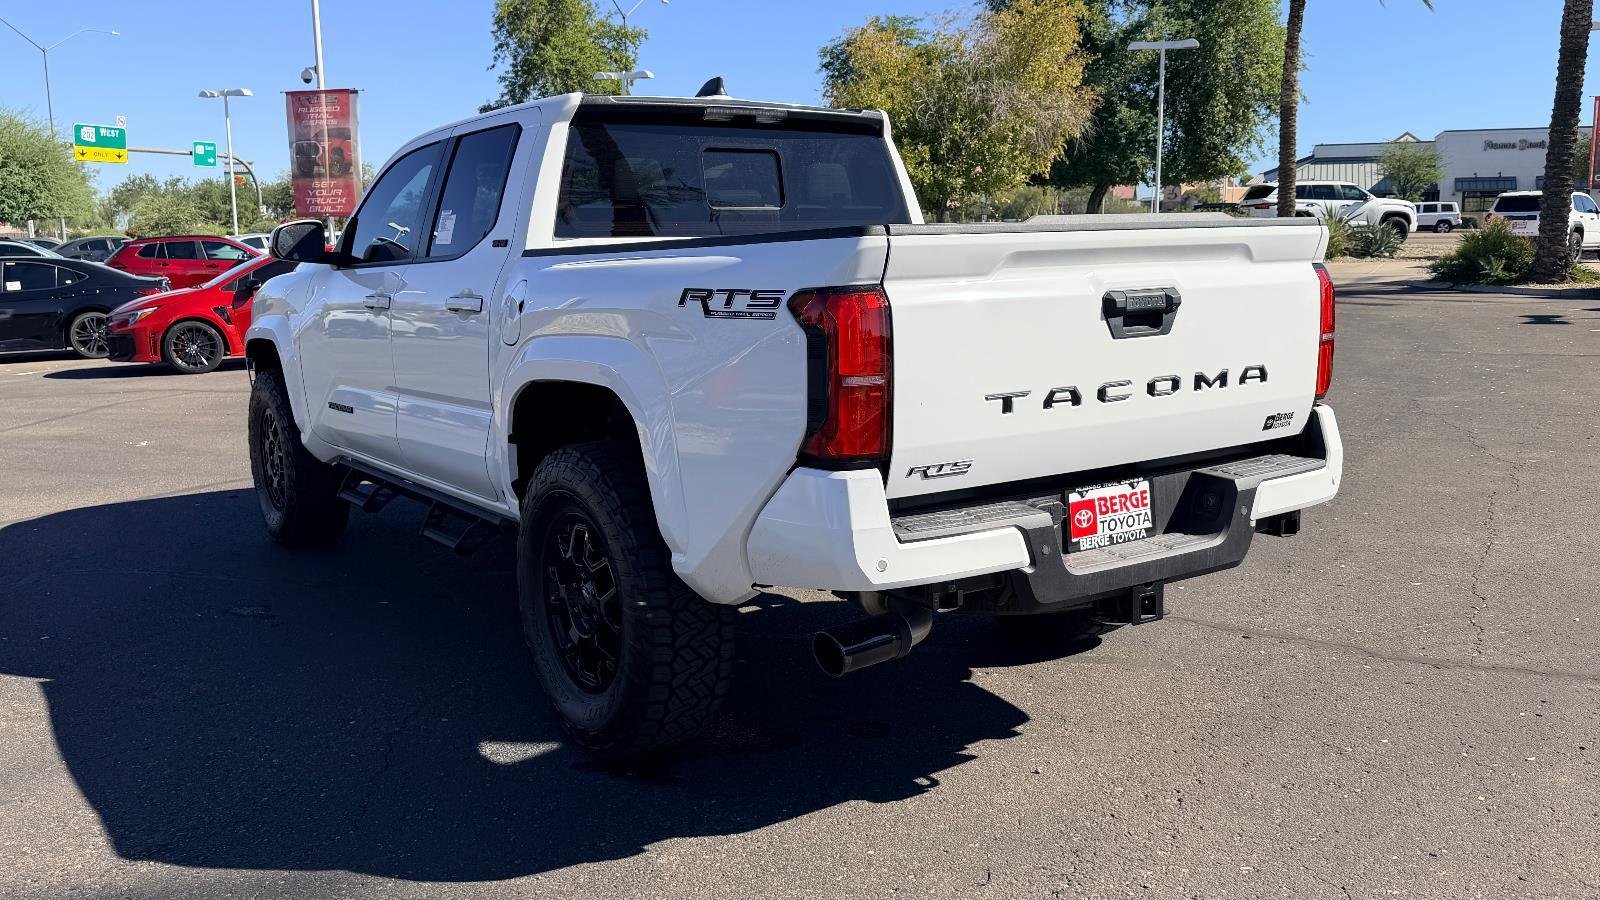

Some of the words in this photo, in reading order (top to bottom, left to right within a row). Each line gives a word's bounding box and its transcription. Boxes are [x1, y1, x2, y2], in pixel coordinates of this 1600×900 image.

[82, 130, 95, 140] 202
[99, 127, 120, 138] WEST
[678, 288, 786, 315] RTS
[1128, 295, 1164, 308] TOYOTA
[984, 364, 1269, 414] TACOMA
[905, 459, 974, 480] RTS
[1097, 490, 1149, 515] BERGE
[1100, 511, 1152, 533] TOYOTA
[1079, 535, 1110, 550] BERGE
[1112, 529, 1147, 544] TOYOTA
